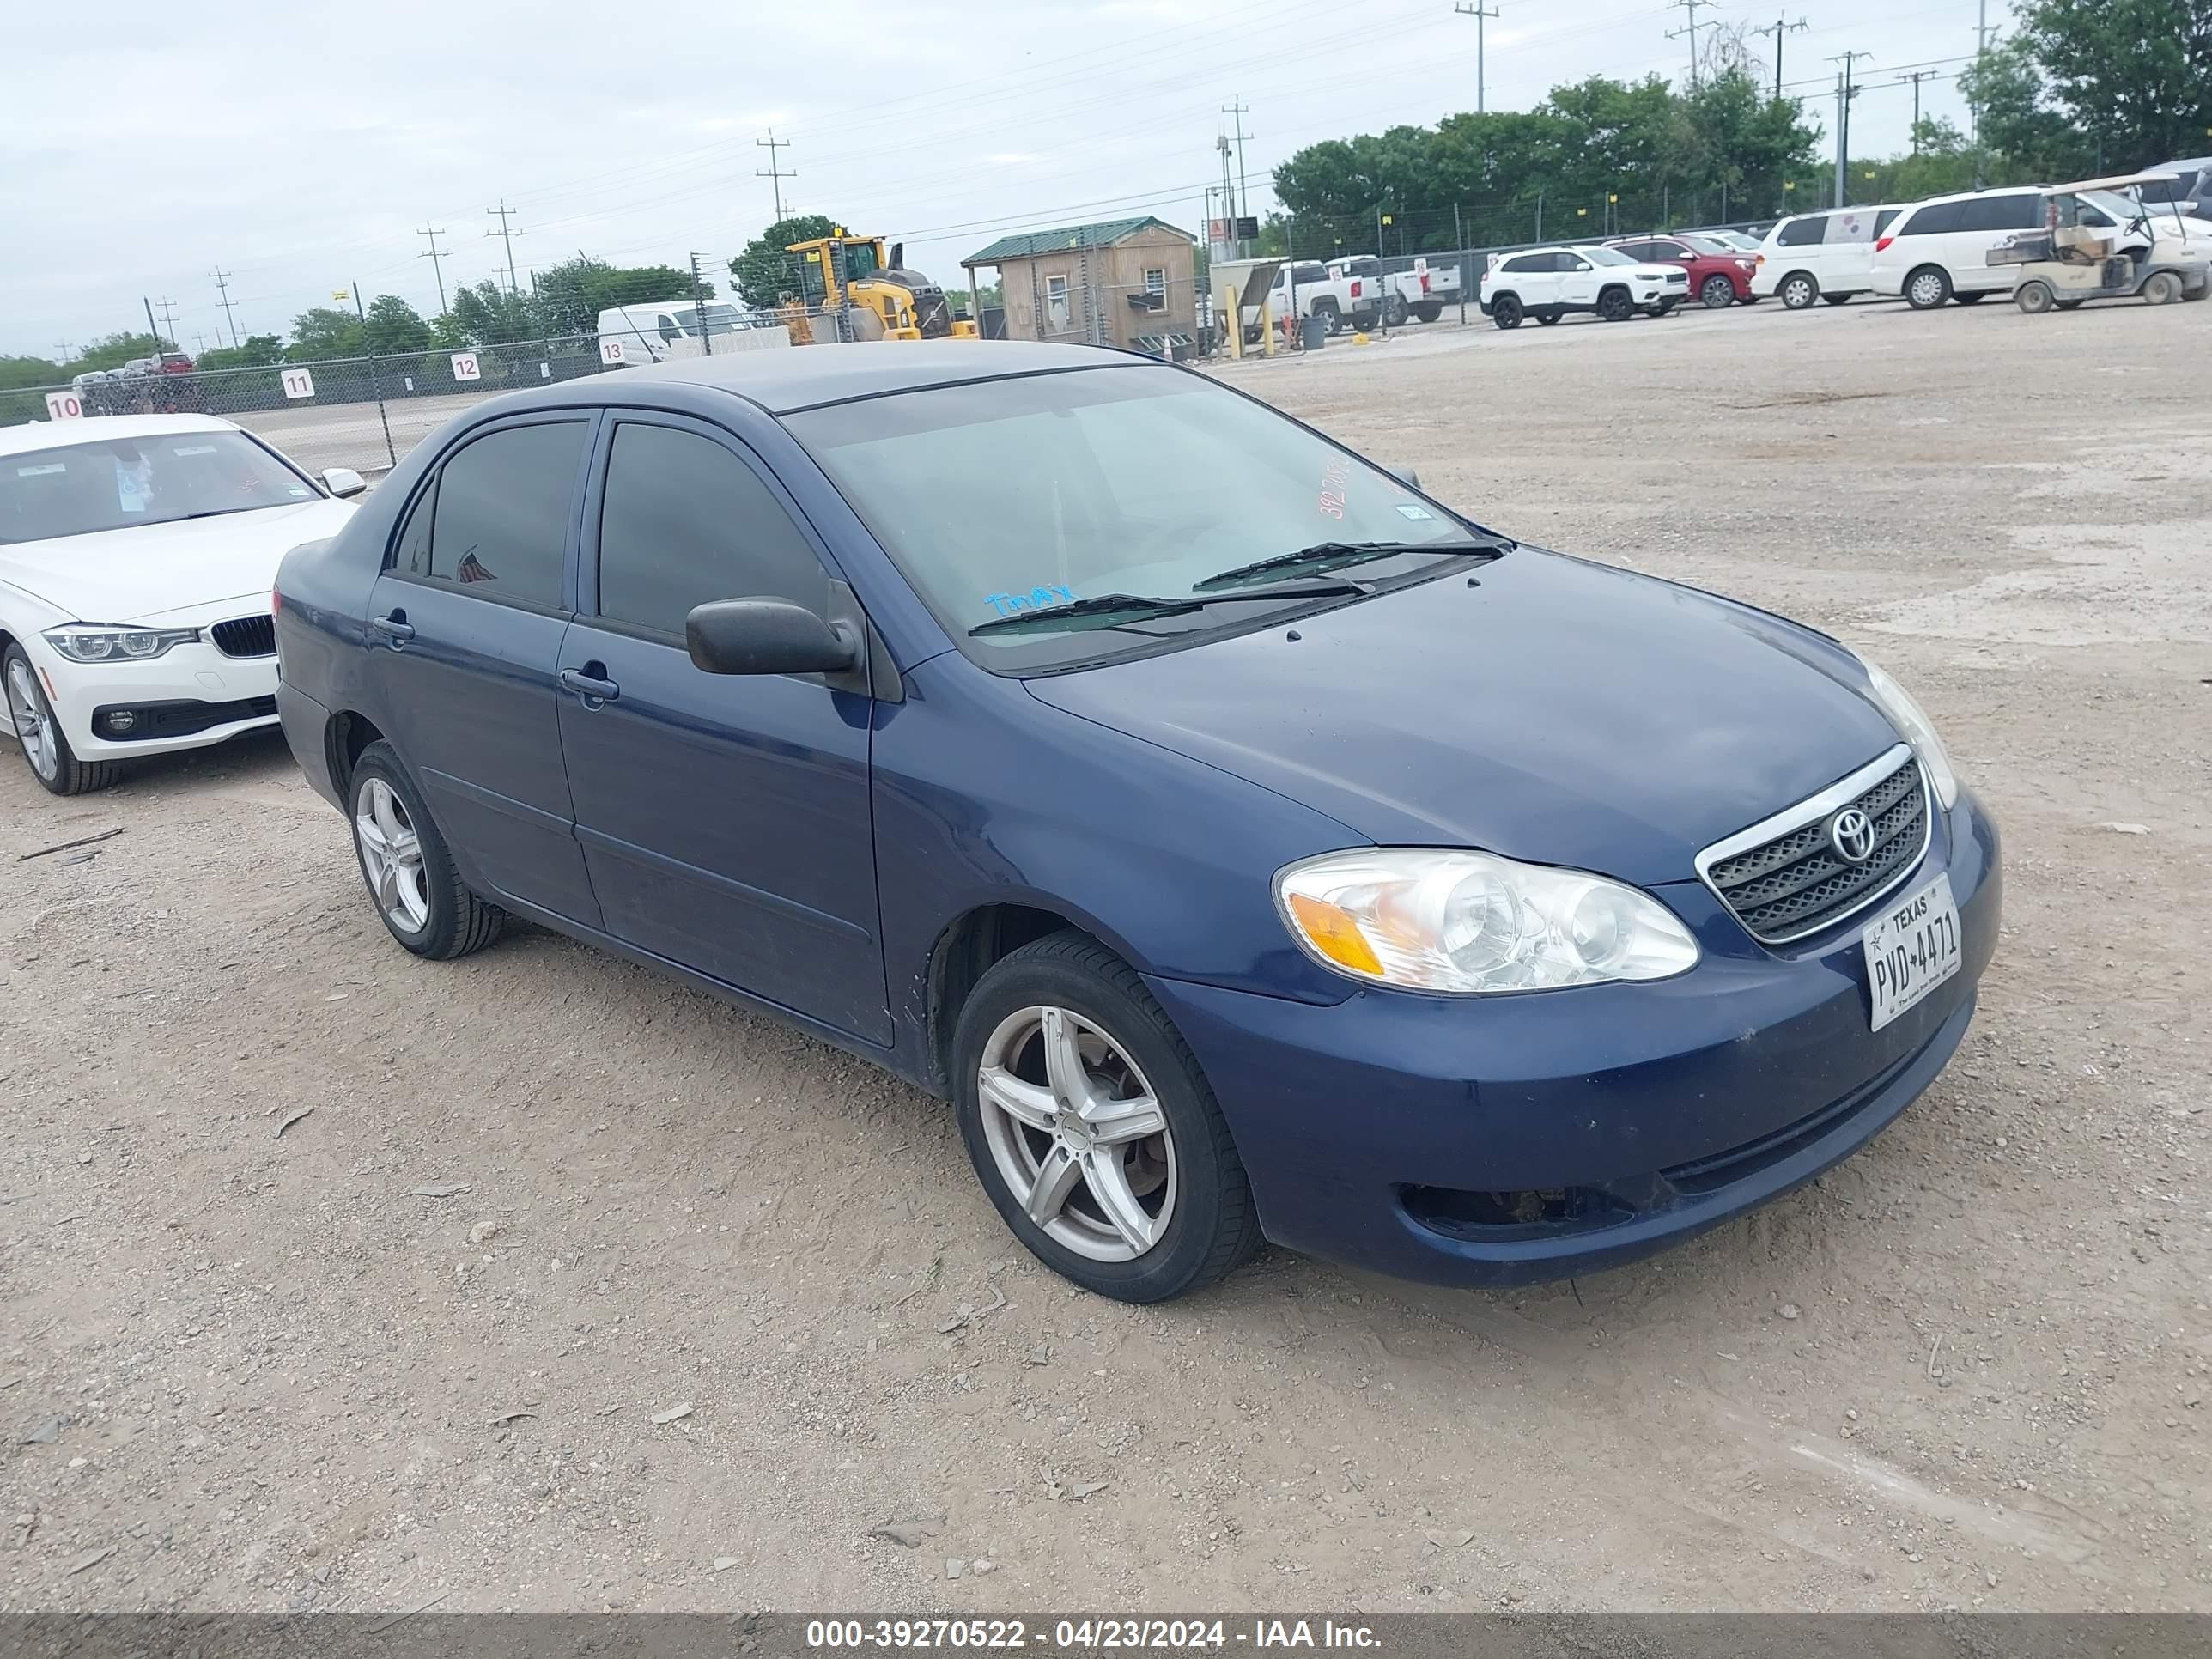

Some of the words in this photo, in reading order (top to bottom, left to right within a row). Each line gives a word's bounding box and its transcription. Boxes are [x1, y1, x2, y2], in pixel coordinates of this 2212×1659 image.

[603, 343, 622, 360] 13
[455, 359, 477, 376] 12
[286, 374, 308, 393] 11
[49, 397, 80, 418] 10
[1893, 896, 1928, 933] TEXAS
